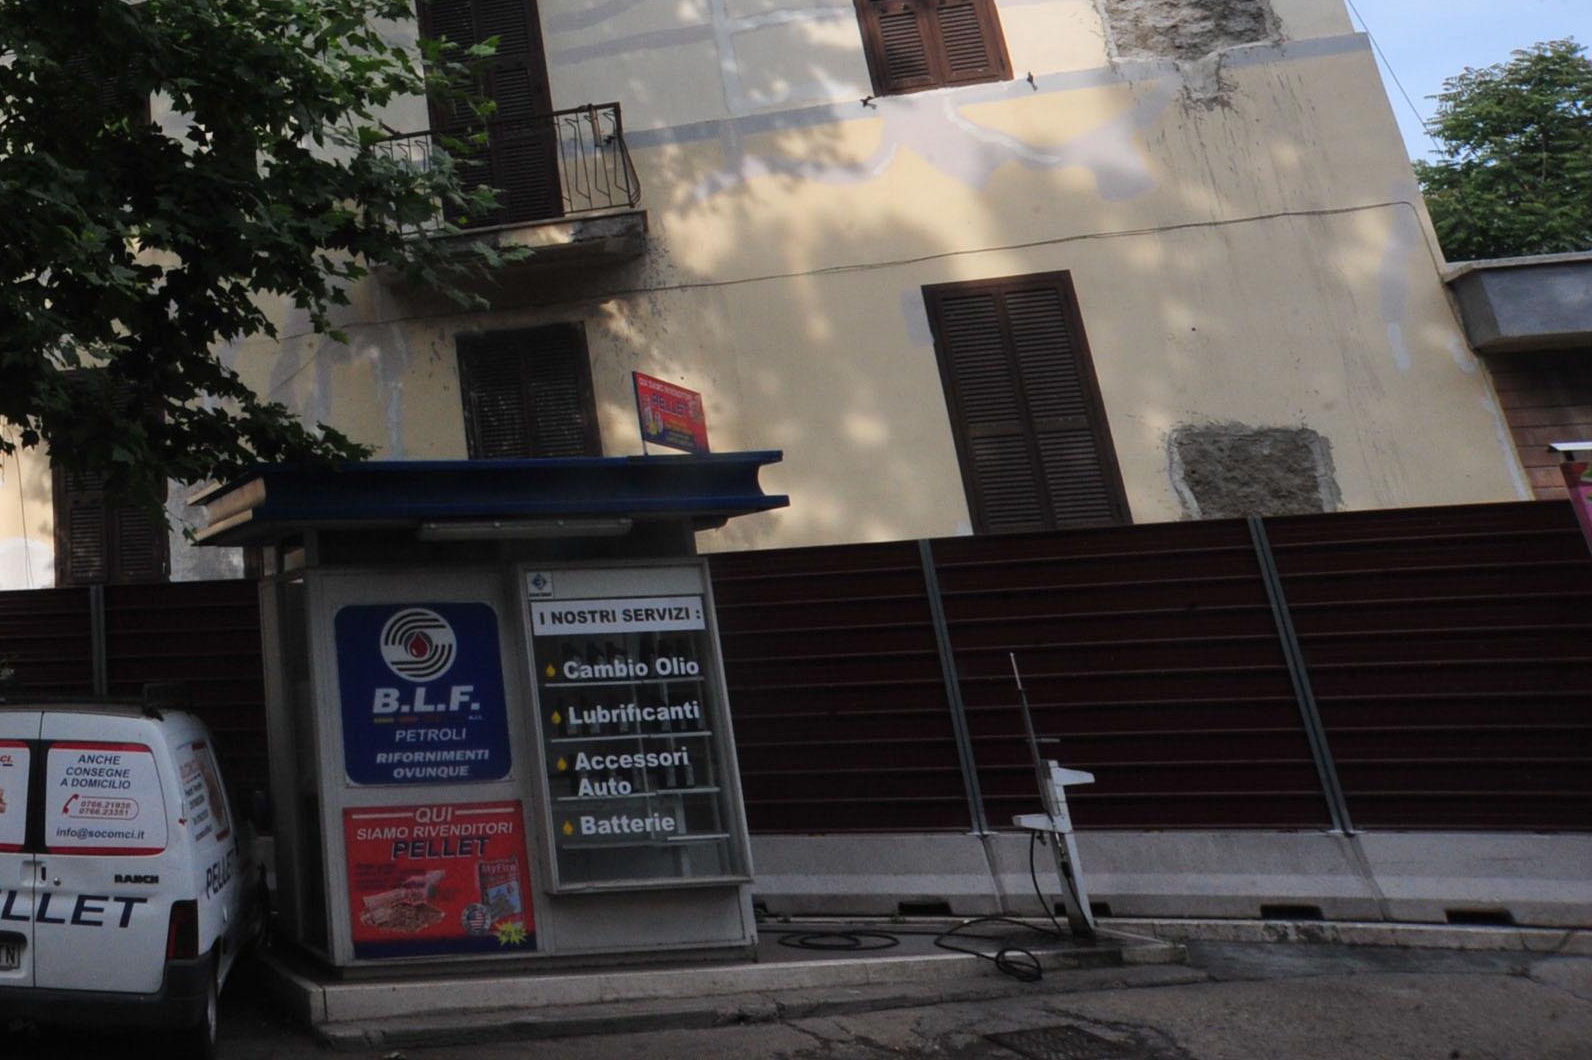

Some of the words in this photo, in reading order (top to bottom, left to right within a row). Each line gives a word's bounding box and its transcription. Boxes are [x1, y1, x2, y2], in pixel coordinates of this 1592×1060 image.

[540, 611, 546, 624] I
[551, 609, 617, 625] NOSTRI
[622, 606, 690, 622] SERVIZI
[563, 659, 649, 680] Cambio
[655, 657, 700, 676] Olio
[373, 685, 480, 713] B.L.F.
[568, 700, 700, 725] Lubrificanti
[395, 727, 466, 742] PETROLI
[78, 754, 121, 765] ANCHE
[376, 749, 489, 764] RIFORNIMENTI
[575, 745, 689, 771] Accessori
[65, 767, 131, 779] CONSEGNE
[392, 765, 470, 779] OVUNQUE
[60, 778, 69, 788] A
[71, 778, 131, 790] DOMICILIO
[578, 778, 633, 797] Auto
[415, 807, 452, 823] QUI
[580, 813, 676, 836] Batterie
[56, 827, 145, 840] info@socomci.it
[357, 826, 409, 841] SIAMO
[413, 822, 513, 838] RIVENDITORI
[391, 836, 490, 860] PELLET
